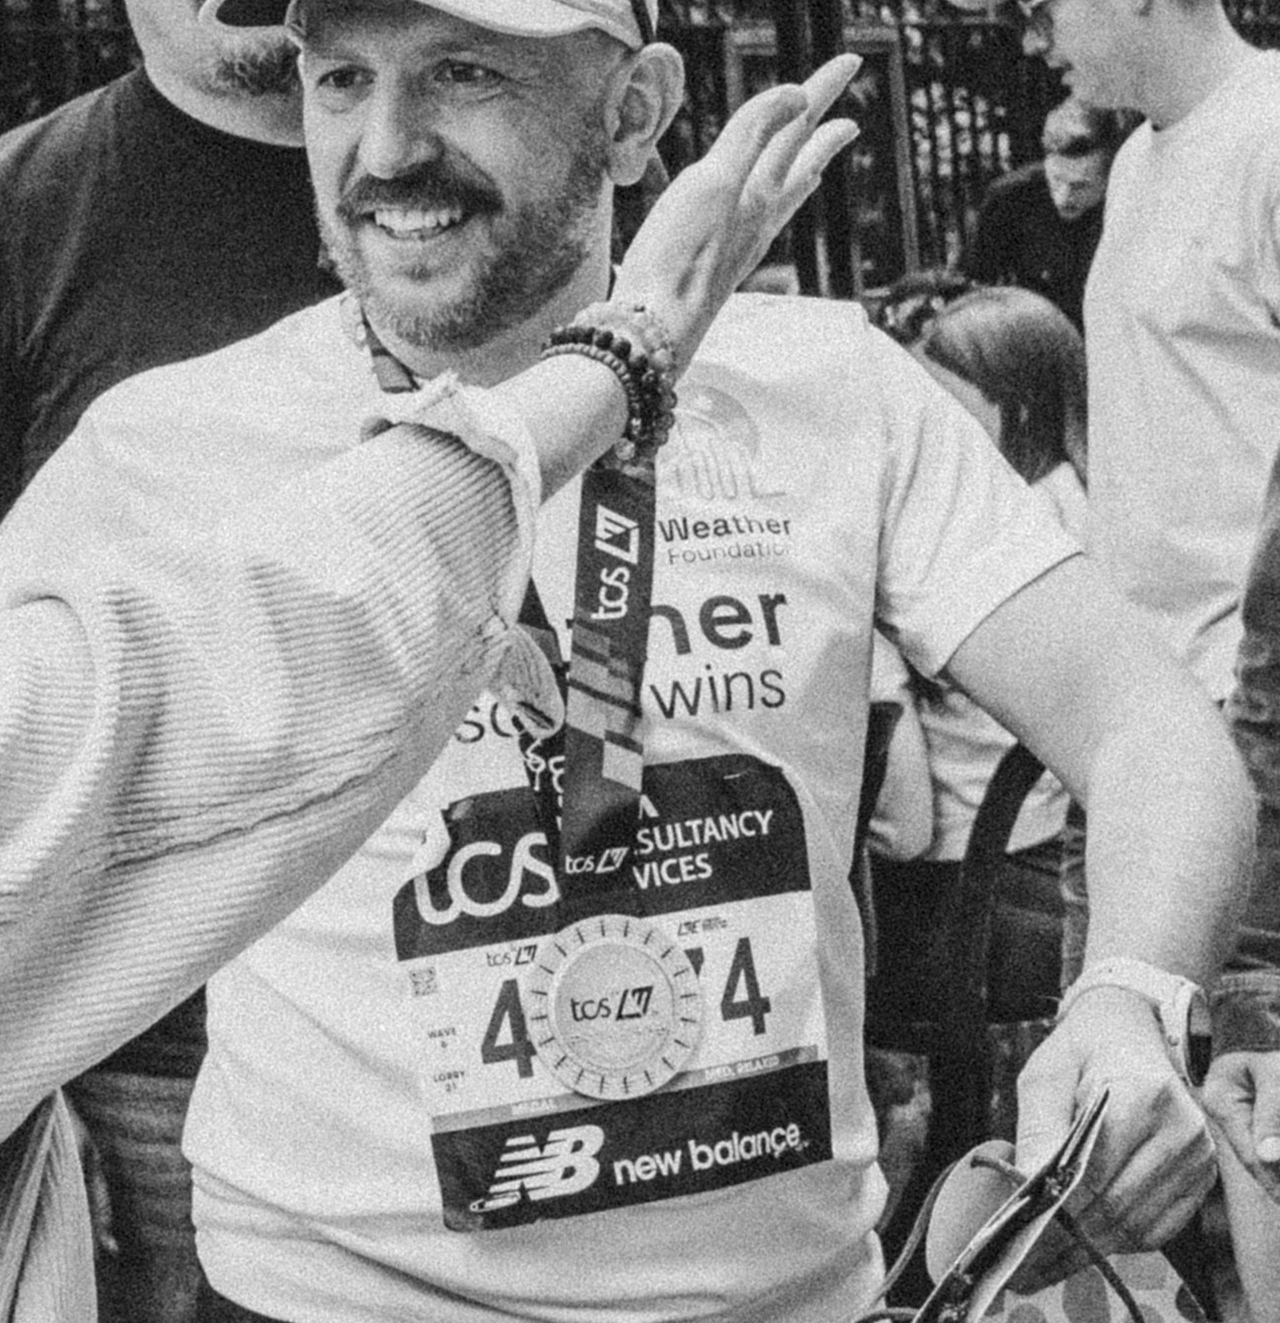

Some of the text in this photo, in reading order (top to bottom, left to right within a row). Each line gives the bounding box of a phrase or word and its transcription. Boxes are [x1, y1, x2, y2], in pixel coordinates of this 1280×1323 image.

[657, 513, 791, 543] Weather
[590, 566, 630, 620] tcs
[649, 664, 786, 719] wins
[635, 809, 773, 855] SULTANCY
[632, 853, 712, 890] VICES
[570, 997, 612, 1023] tcs
[614, 1123, 801, 1186] new balance
